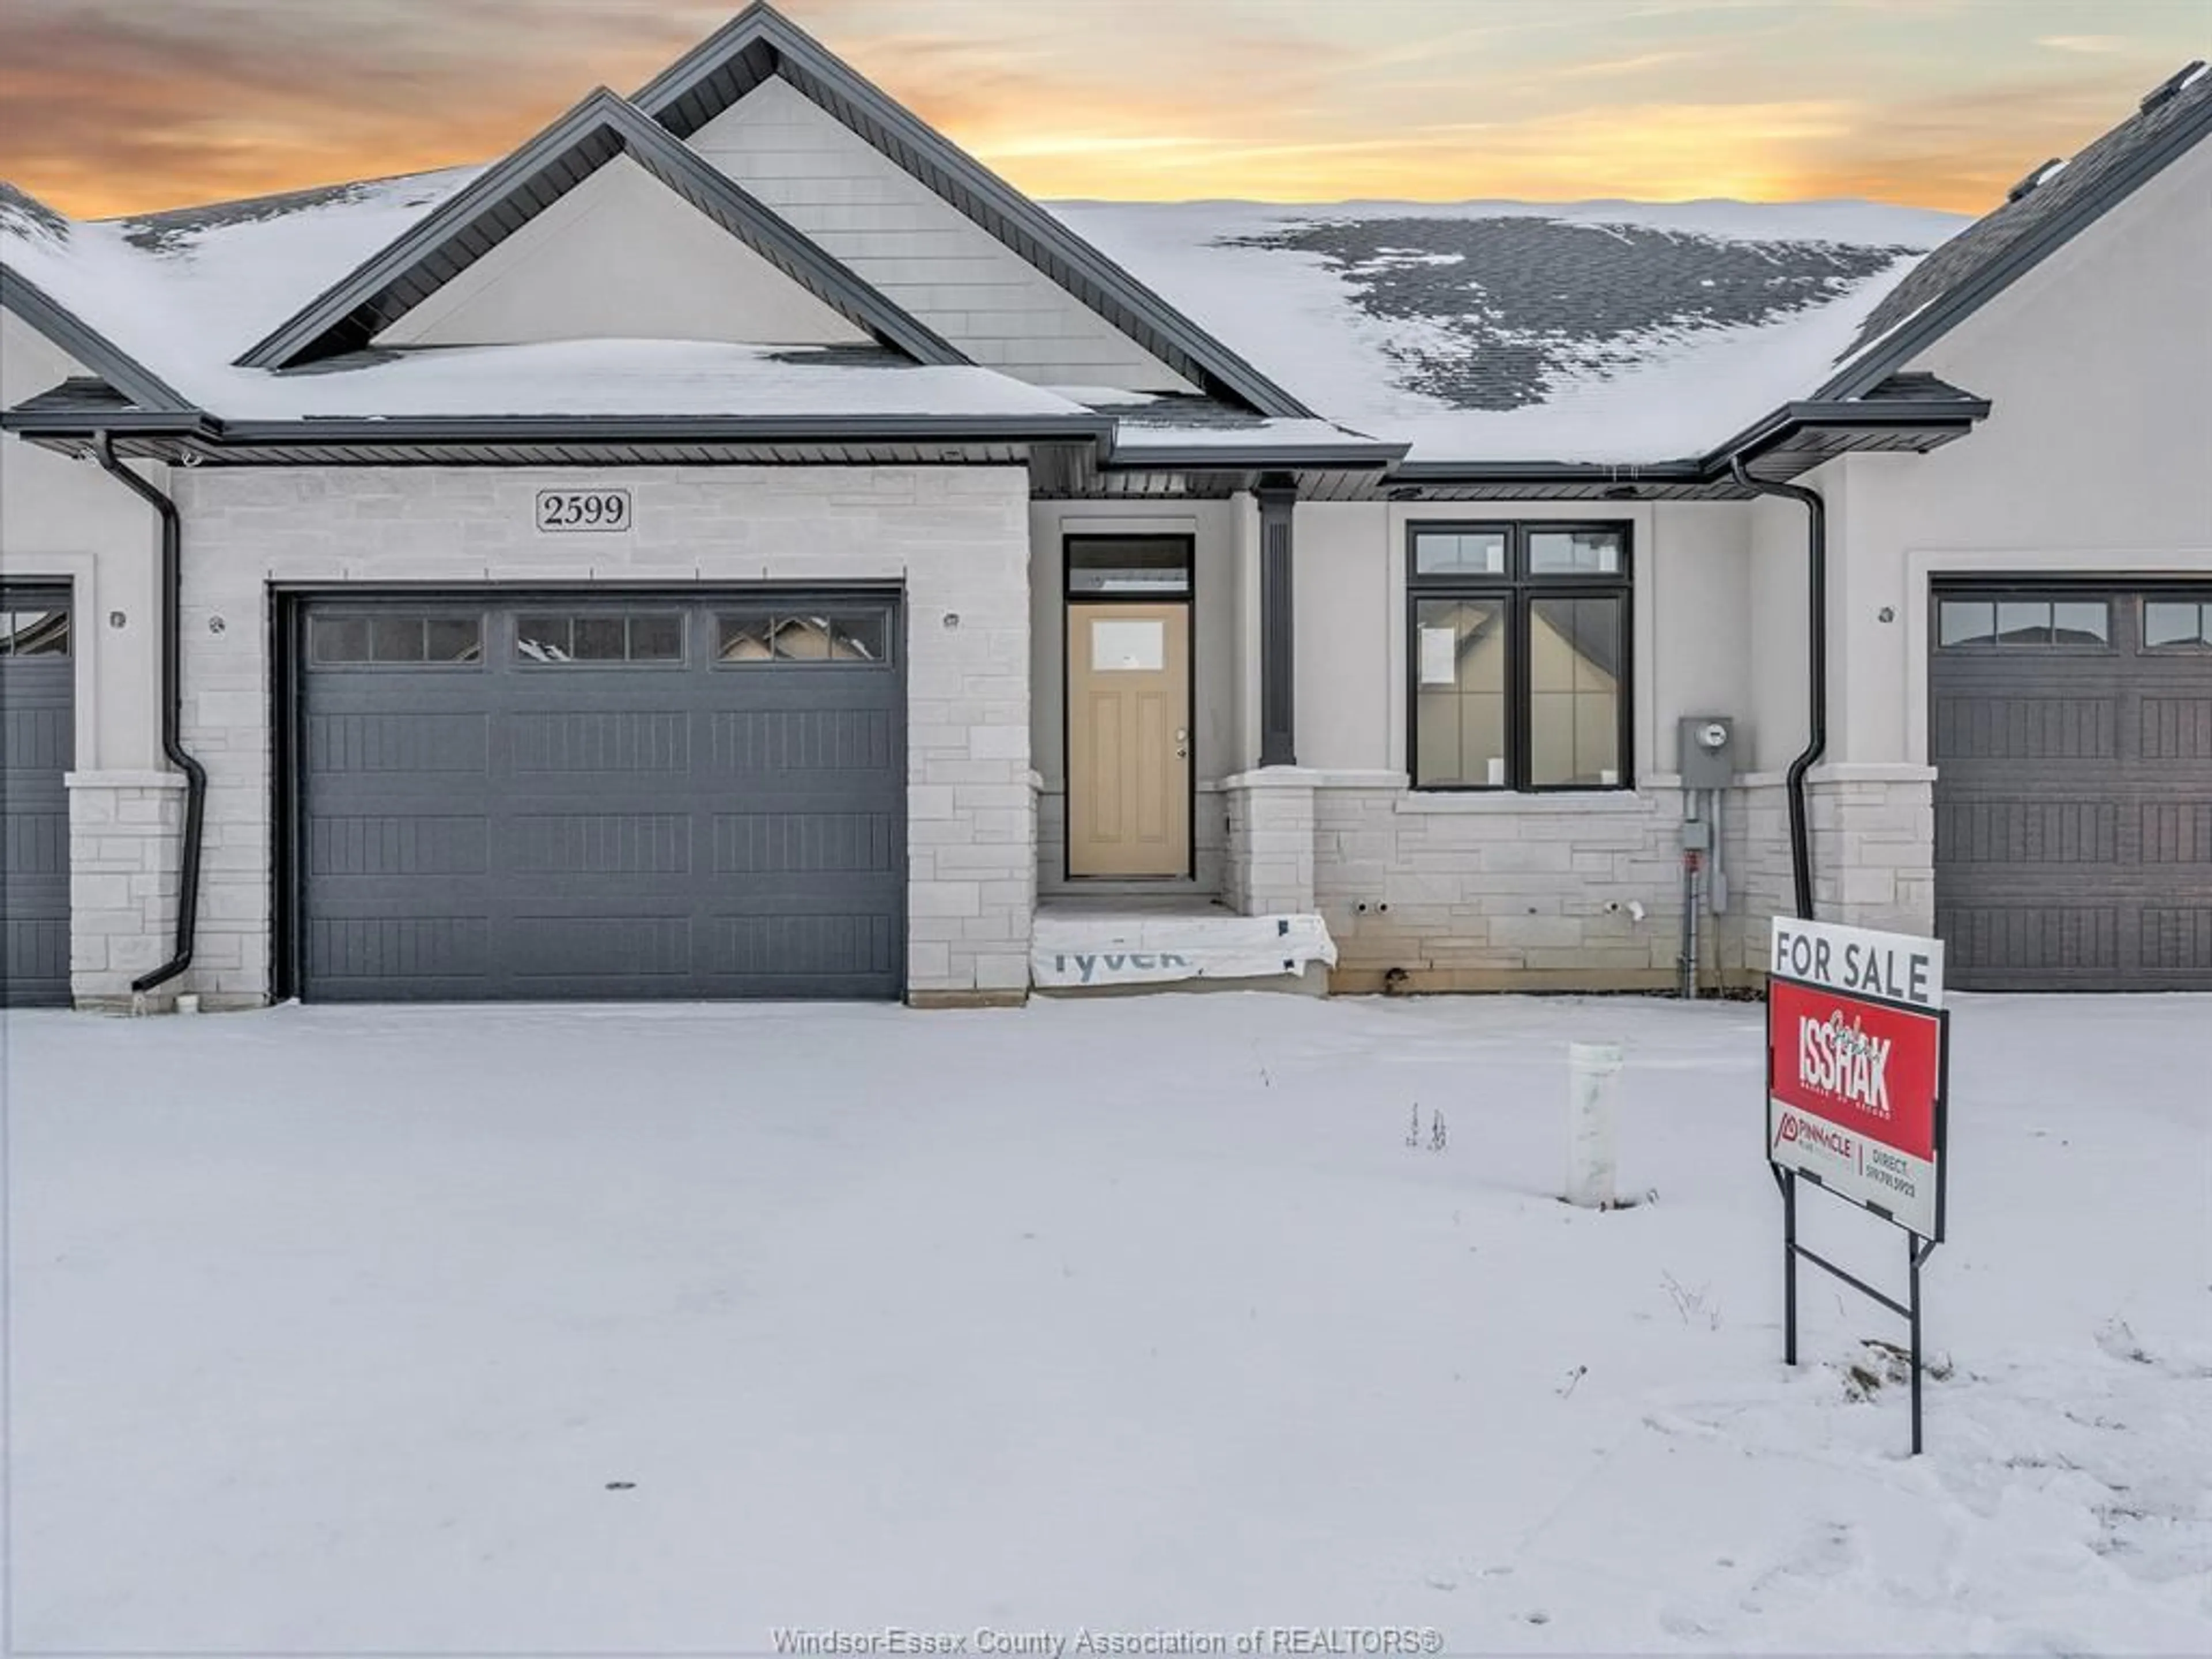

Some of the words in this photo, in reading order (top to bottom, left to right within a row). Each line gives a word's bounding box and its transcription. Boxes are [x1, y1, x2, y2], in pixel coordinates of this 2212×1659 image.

[544, 494, 623, 524] 2599
[1777, 931, 1831, 982] FOR
[1844, 943, 1929, 1003] SALE
[1799, 1016, 1892, 1112] ISSHAK
